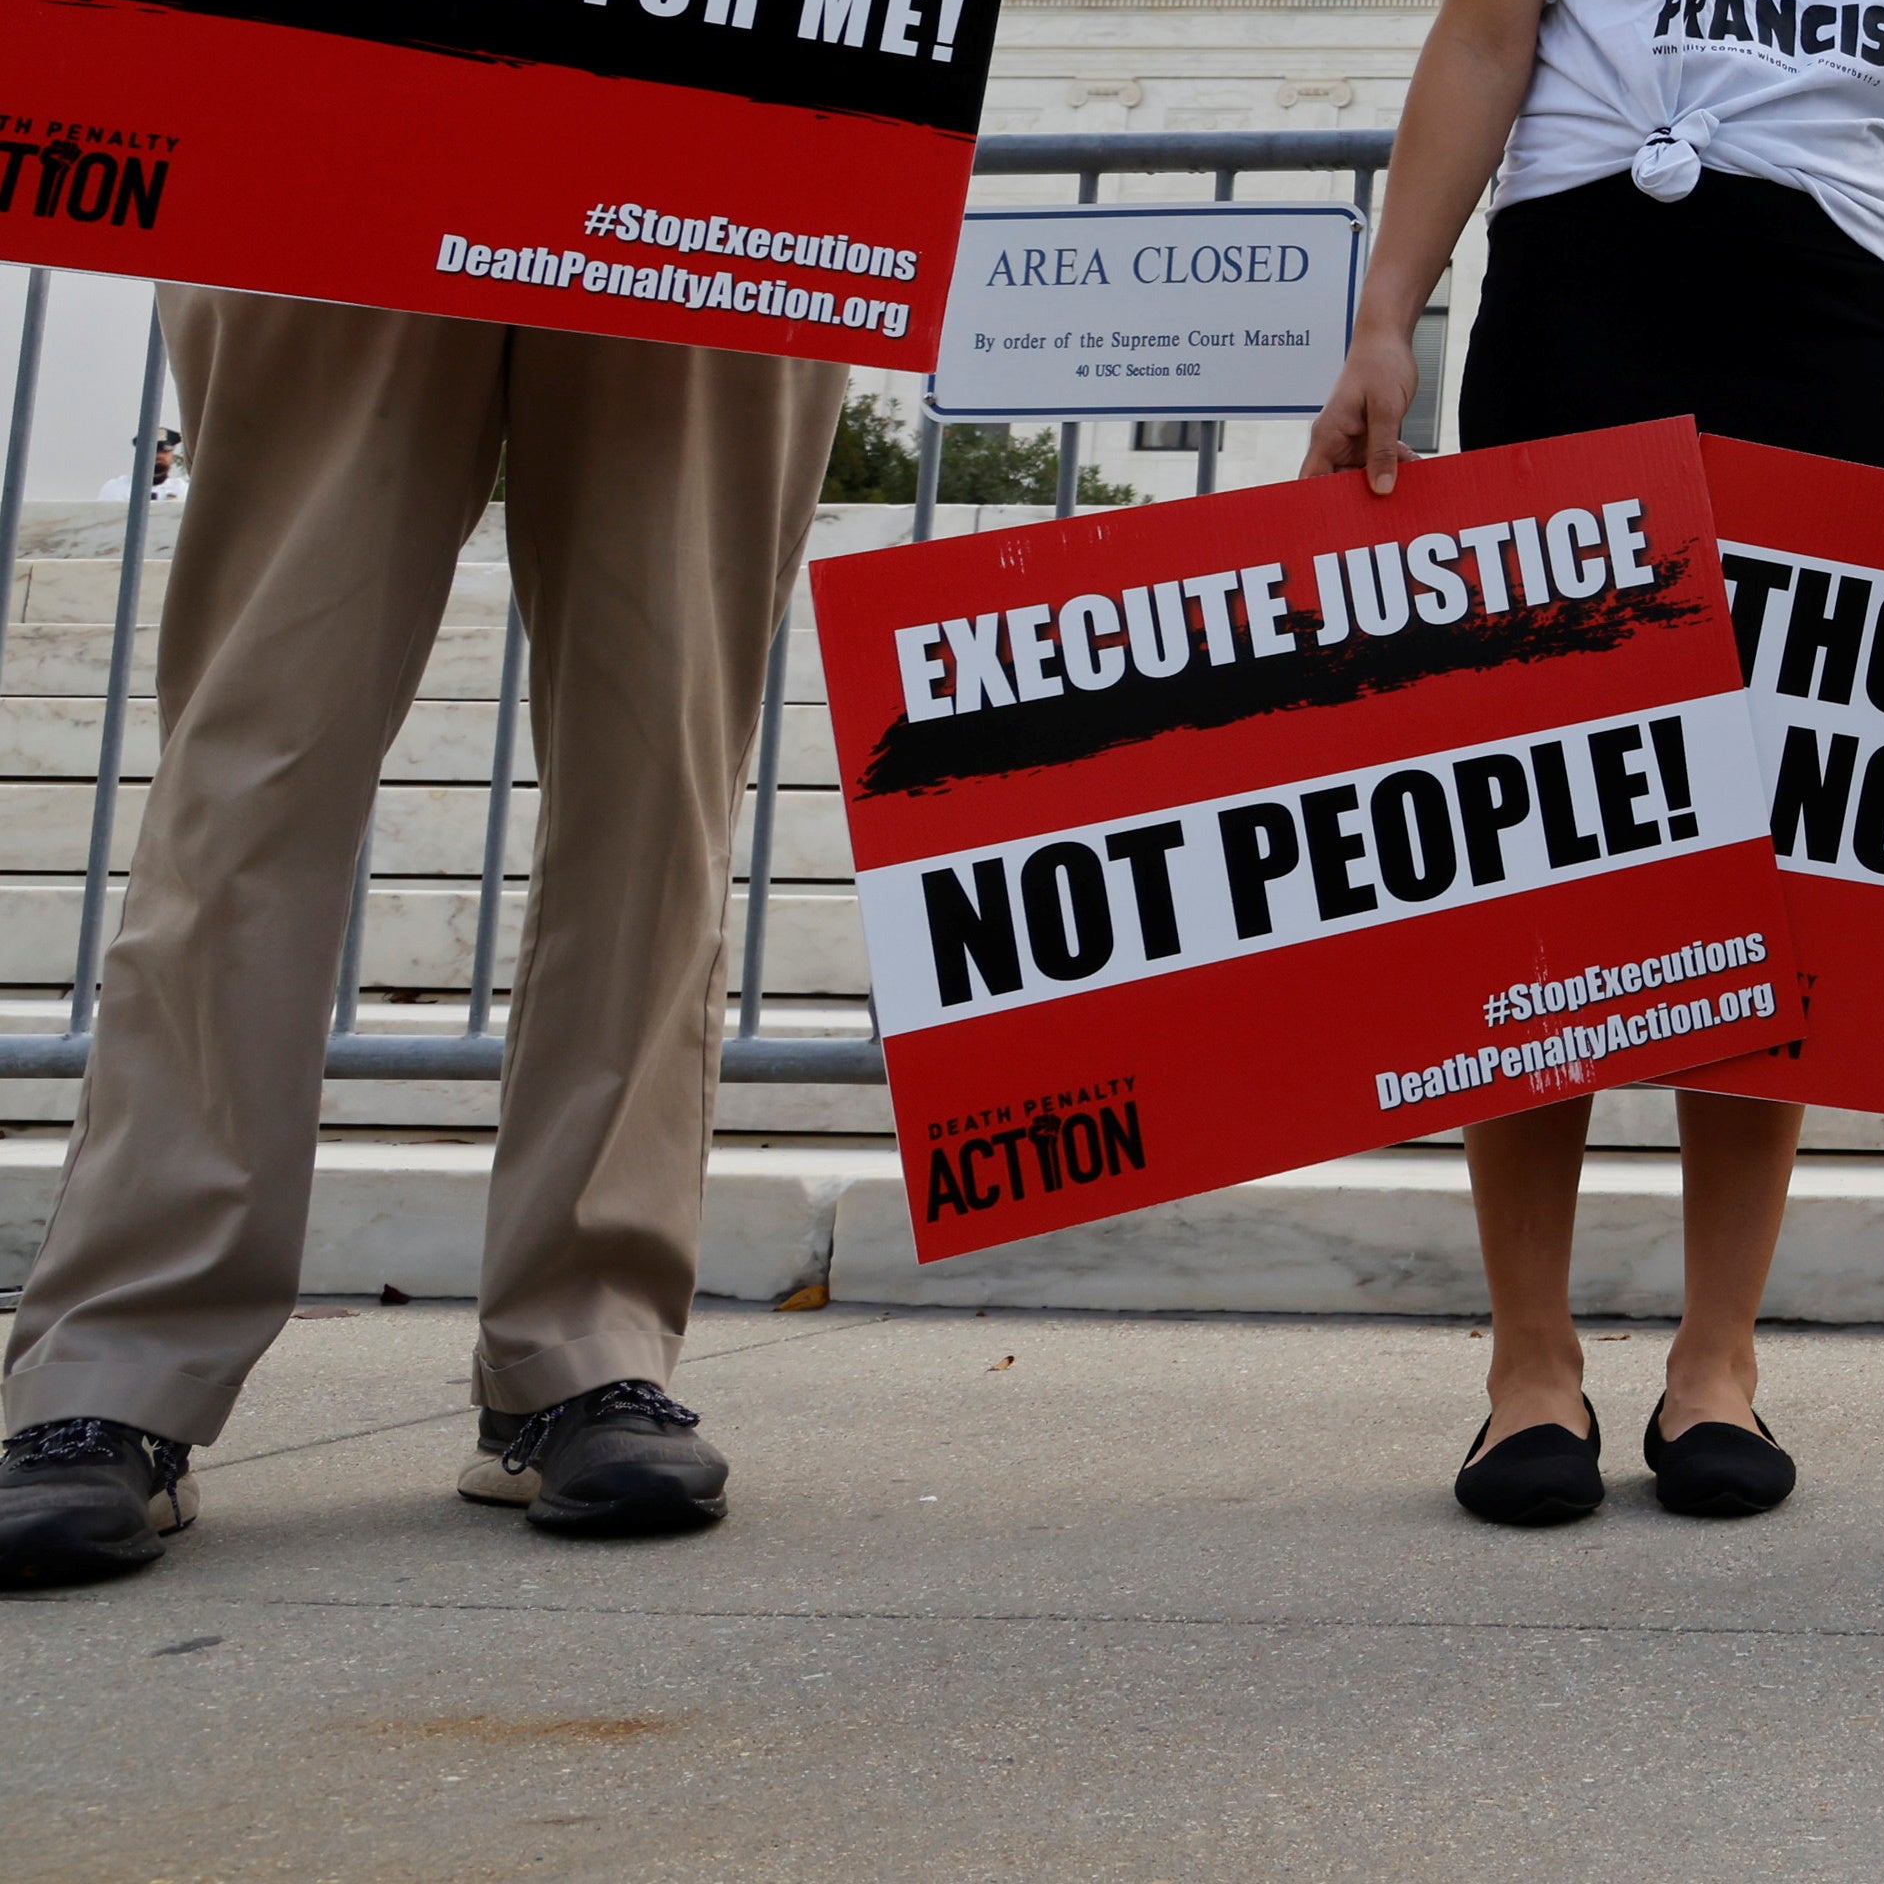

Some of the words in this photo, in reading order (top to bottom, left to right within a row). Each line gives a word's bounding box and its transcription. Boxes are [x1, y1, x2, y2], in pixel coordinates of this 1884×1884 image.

[1711, 45, 1752, 55] comes
[1817, 57, 1861, 79] Proverbs
[46, 121, 181, 153] PENALTY
[584, 202, 918, 282] #StopExecutions
[985, 247, 1112, 287] AREA
[1132, 244, 1310, 285] CLOSED
[435, 233, 910, 339] DeathPenaltyAction.org
[974, 333, 996, 353] By
[1003, 333, 1047, 349] order
[1054, 332, 1073, 349] of
[1080, 332, 1104, 349] the
[1111, 330, 1180, 352] Supreme
[1187, 330, 1235, 348] Court
[1244, 329, 1311, 347] Marshal
[1075, 364, 1090, 378] 40
[1095, 363, 1122, 377] USC
[1125, 363, 1170, 377] Section
[1175, 363, 1201, 377] 6102
[894, 562, 1296, 723] EXECUTE
[1312, 498, 1657, 649] JUSTICE
[920, 819, 1186, 1008] NOT
[1216, 716, 1700, 942] PEOPLE!
[1482, 932, 1768, 1028] #StopExecutions
[1375, 982, 1777, 1110] DeathPenaltyAction.org
[928, 1106, 1012, 1141] DEATH
[1023, 1075, 1136, 1117] PENALTY
[926, 1101, 1147, 1223] ACTION
